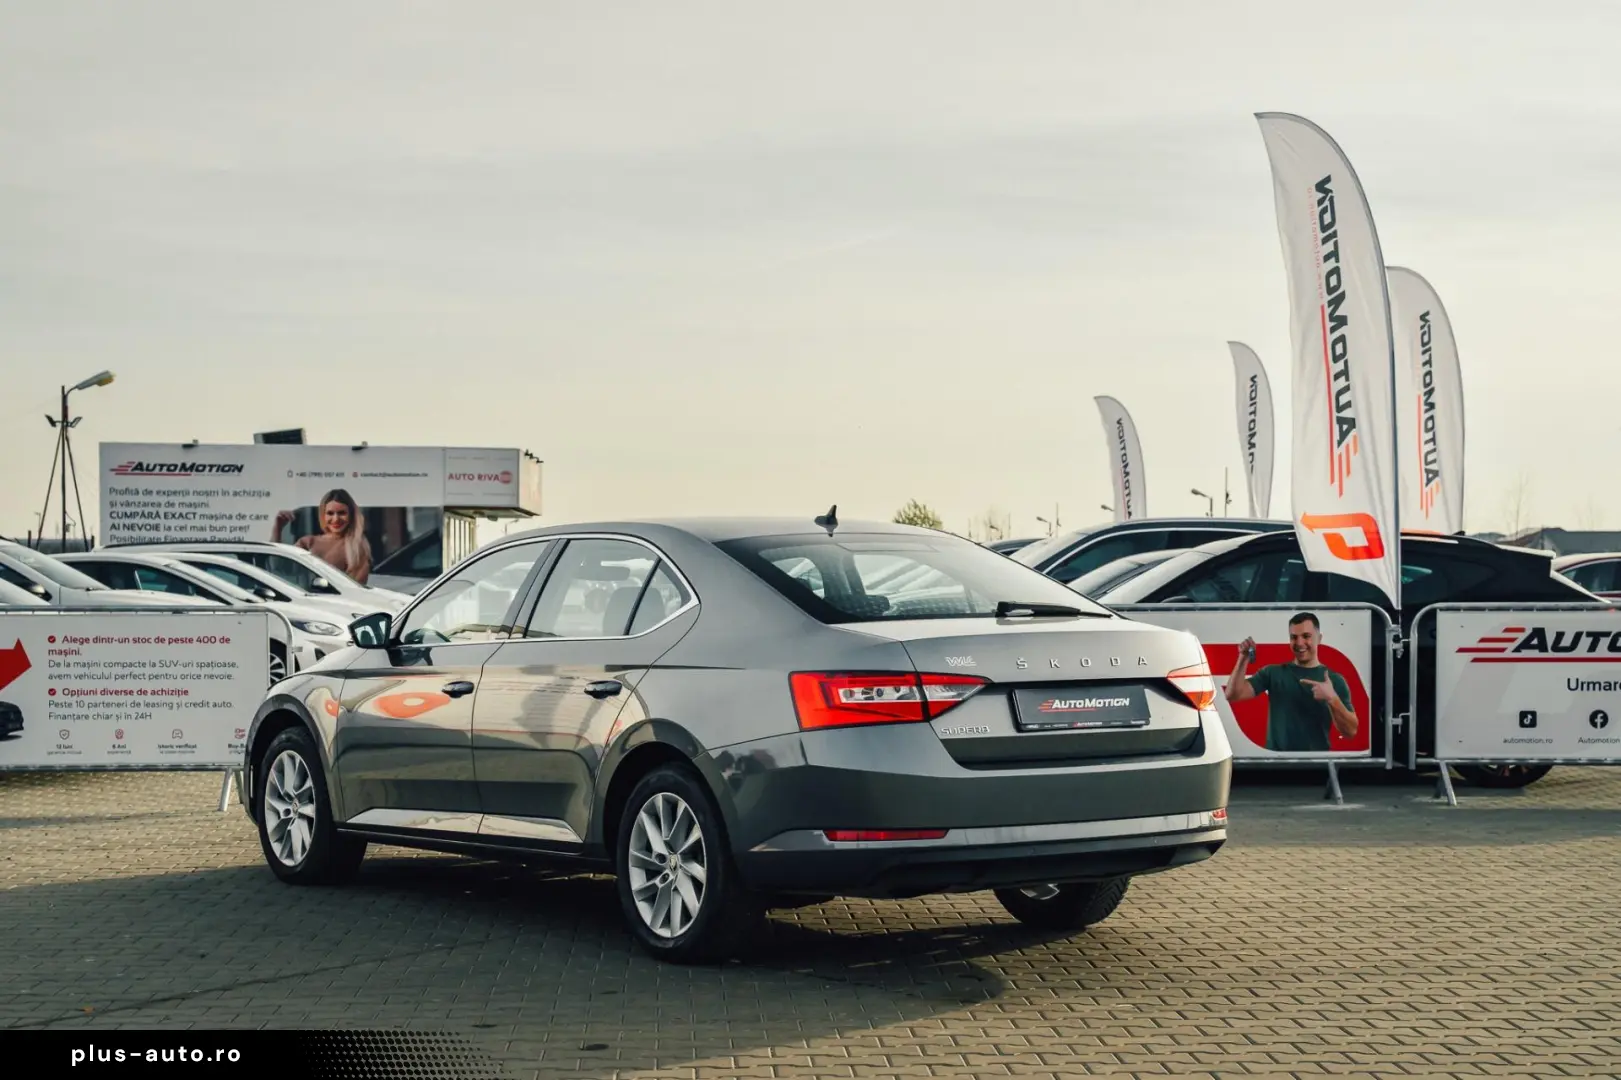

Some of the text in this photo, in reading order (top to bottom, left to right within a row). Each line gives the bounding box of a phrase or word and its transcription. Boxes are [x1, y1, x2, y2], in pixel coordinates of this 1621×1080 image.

[131, 461, 244, 473] AUTOMOTION
[448, 472, 475, 481] AUTO
[109, 486, 140, 497] Profită
[142, 487, 154, 497] de
[164, 500, 176, 508] de
[163, 511, 198, 520] EXACT
[235, 512, 247, 521] de
[249, 513, 269, 521] care
[109, 523, 121, 532] AI
[122, 523, 161, 532] NEVOIE
[163, 523, 172, 532] la
[173, 523, 187, 532] cel
[189, 523, 207, 532] mai
[208, 524, 228, 532] bun
[61, 635, 231, 646] Alege dintr-un stoc de peste 400 de
[48, 648, 82, 658] mașini.
[48, 660, 61, 669] De
[63, 660, 71, 669] la
[73, 660, 101, 670] mașini
[103, 661, 147, 670] compacte
[148, 660, 157, 669] la
[158, 660, 194, 669] SUV-uri
[73, 672, 112, 680] vehiculul
[114, 672, 146, 681] perfect
[148, 672, 178, 682] pentru
[180, 672, 202, 680] orice
[203, 672, 235, 680] nevoie.
[1567, 678, 1621, 692] Urmar
[62, 688, 189, 698] Opțiuni diverse de achiziție
[48, 700, 73, 708] Peste
[75, 700, 85, 708] 10
[87, 700, 128, 710] parteneri
[130, 700, 141, 708] de
[143, 700, 174, 710] leasing
[176, 700, 183, 710] și
[184, 700, 210, 708] credit
[1052, 697, 1130, 709] AUTOMOTION
[48, 712, 90, 723] Finanțare
[91, 712, 113, 720] chiar
[115, 712, 122, 722] și
[134, 712, 152, 720] 24H
[941, 725, 990, 736] SUPERB
